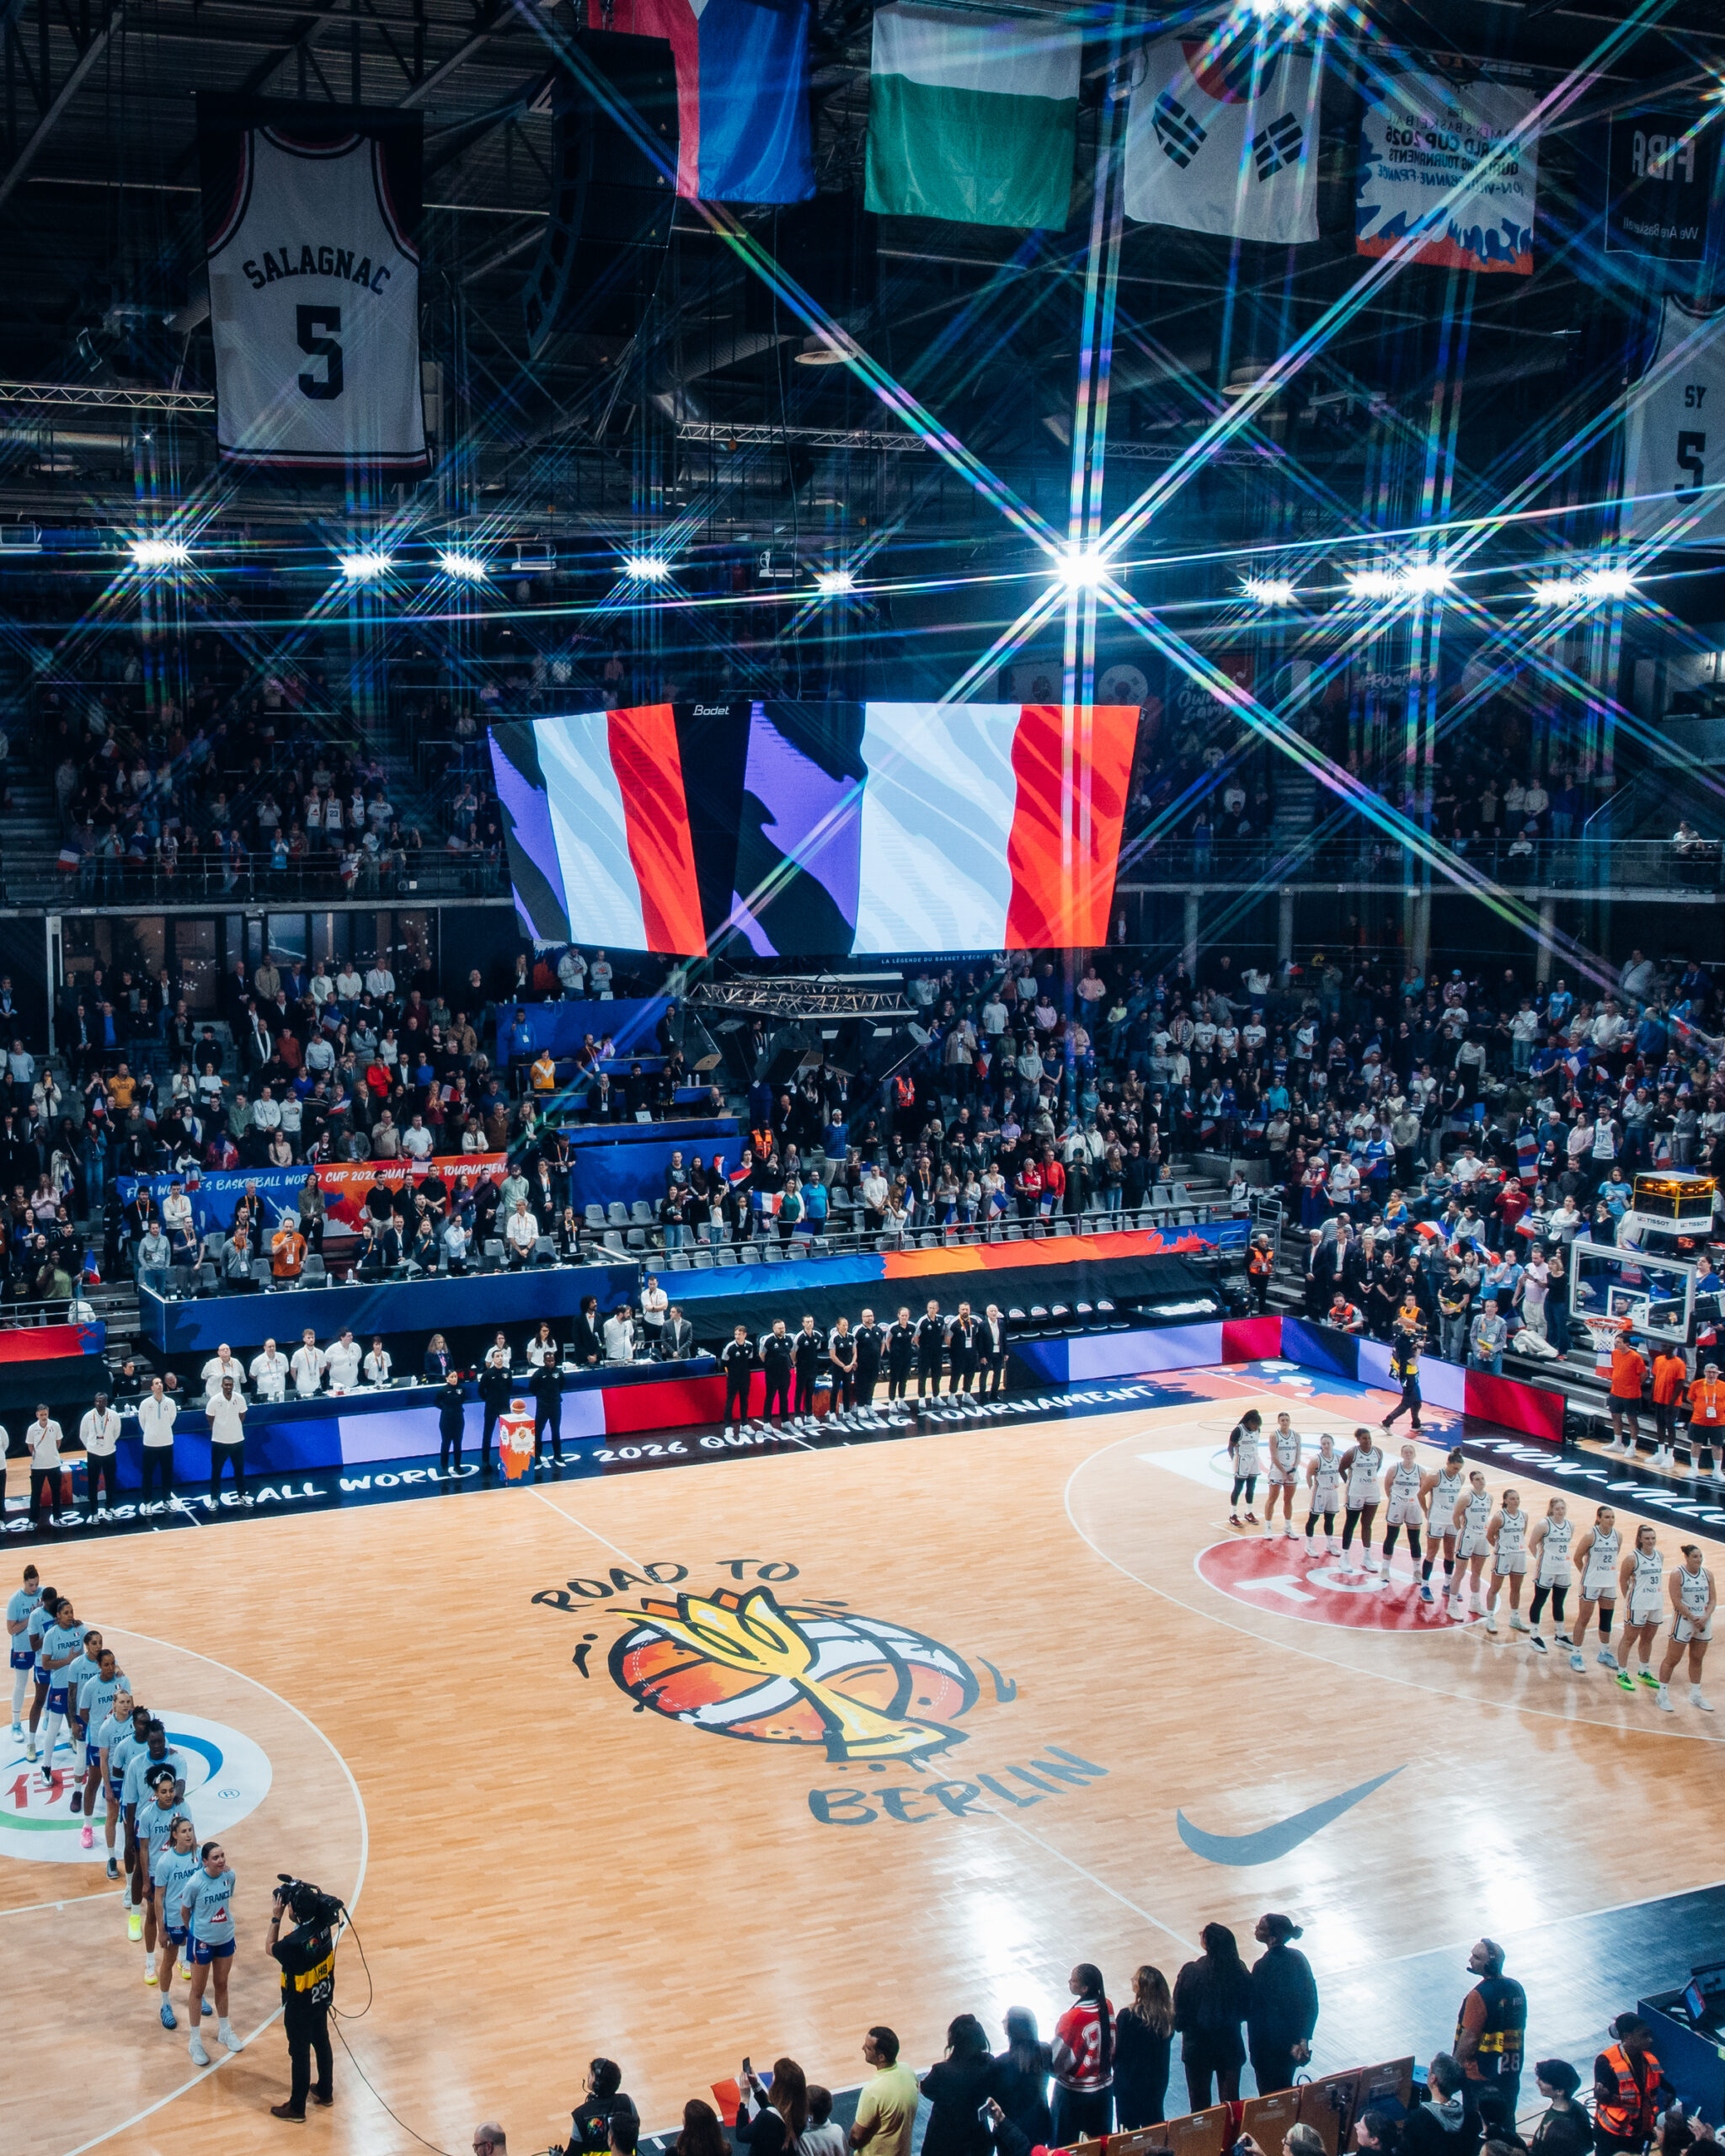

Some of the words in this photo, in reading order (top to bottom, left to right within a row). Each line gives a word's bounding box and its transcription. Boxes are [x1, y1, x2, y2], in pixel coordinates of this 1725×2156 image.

[243, 244, 391, 296] SALAGNAC
[296, 304, 344, 401] 5
[1685, 384, 1707, 409] SY
[1674, 430, 1706, 504] 5
[692, 704, 730, 716] Bodet
[325, 1171, 350, 1183] CUP
[1647, 1218, 1670, 1227] TISSOT
[339, 1464, 480, 1492] WORLD
[591, 1440, 689, 1464] 2026
[917, 1385, 1156, 1422] TOURNAMENT
[1558, 1545, 1567, 1554] 20
[1603, 1555, 1612, 1563] 22
[531, 1561, 689, 1612] ROAD
[715, 1558, 800, 1582] TO
[1650, 1576, 1659, 1585] 33
[1694, 1594, 1705, 1604] 34
[57, 1639, 81, 1650] FRANCE
[808, 1745, 1110, 1826] BERLIN
[174, 1866, 203, 1881] FRANC
[204, 1889, 231, 1905] FRANCE
[317, 1963, 328, 1977] HB
[1501, 2052, 1520, 2073] 28
